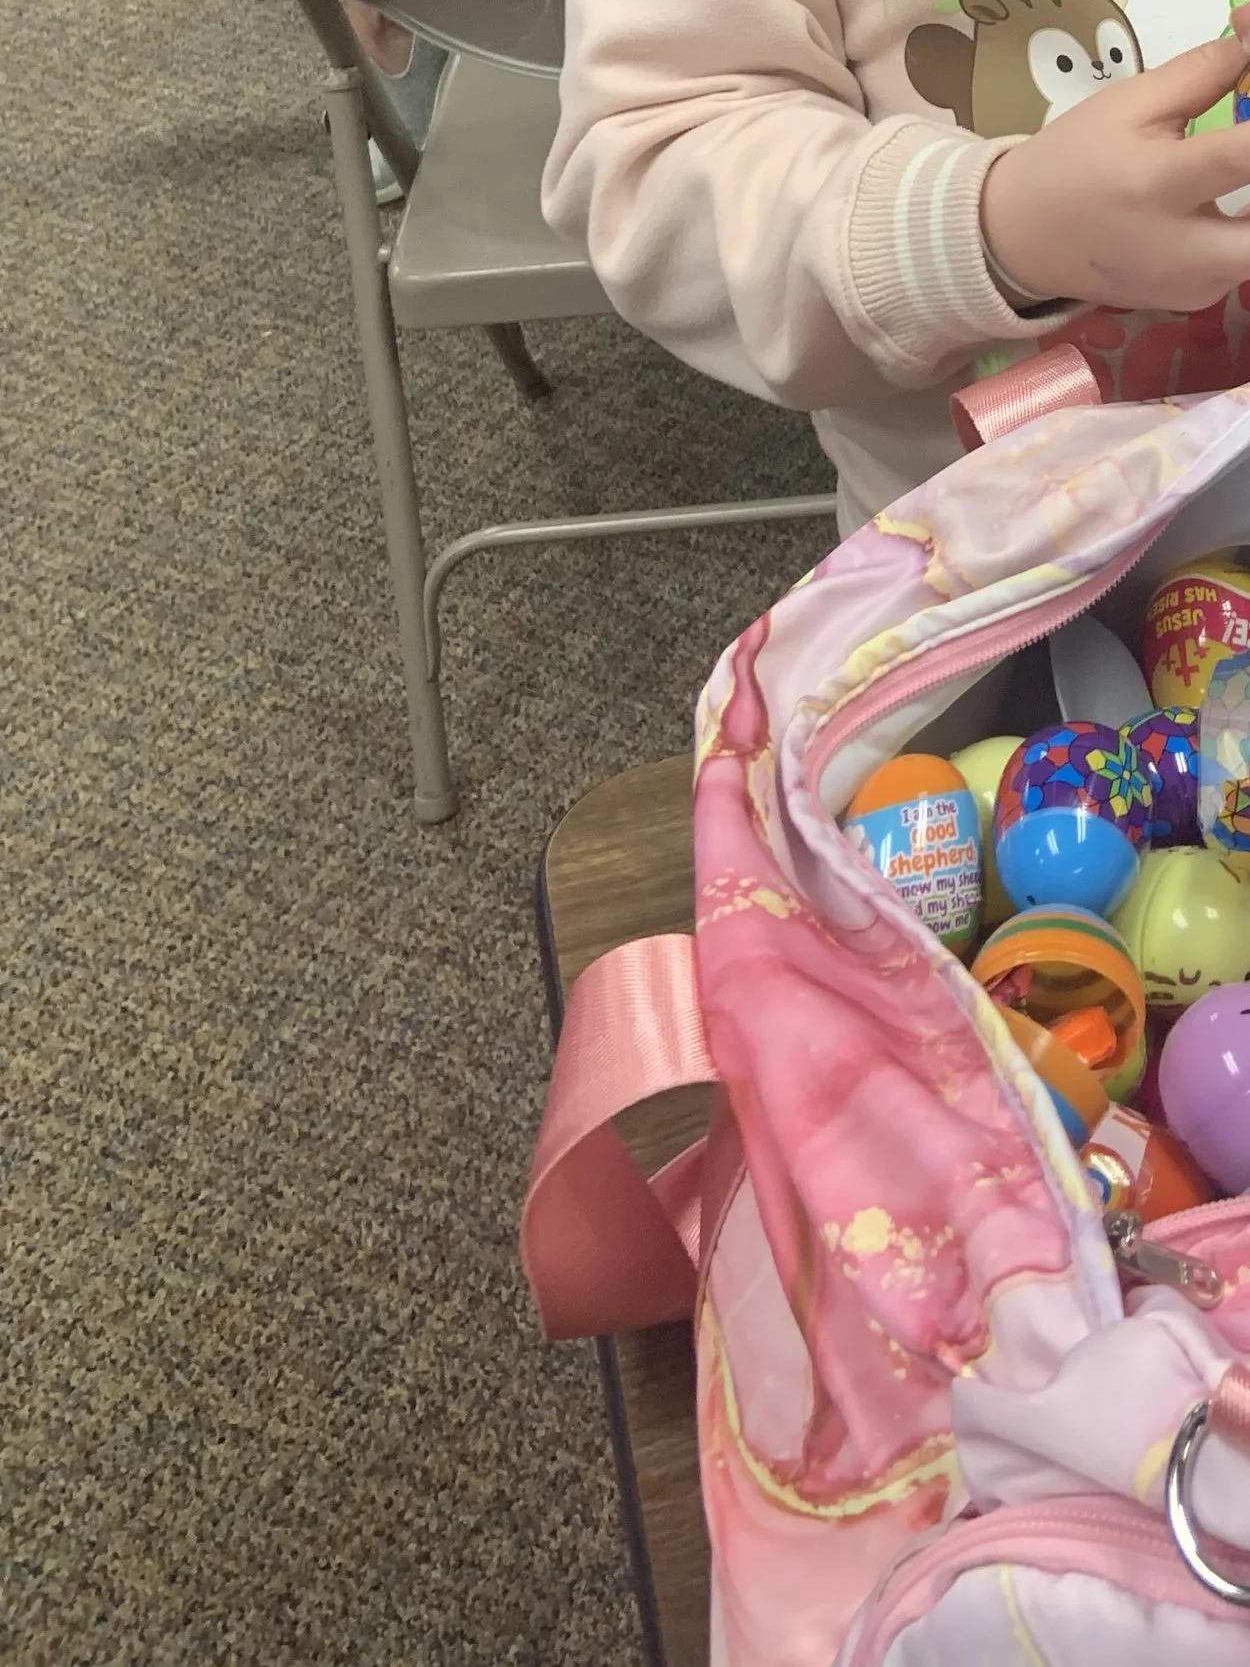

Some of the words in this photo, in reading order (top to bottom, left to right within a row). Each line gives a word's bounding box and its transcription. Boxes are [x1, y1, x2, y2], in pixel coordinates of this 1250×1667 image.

[1150, 590, 1179, 617] RISE
[1184, 586, 1218, 603] HAS
[1156, 608, 1204, 639] JESUS
[936, 799, 957, 816] the
[897, 880, 932, 900] now
[936, 877, 956, 897] my
[927, 897, 948, 918] my
[955, 913, 970, 927] me
